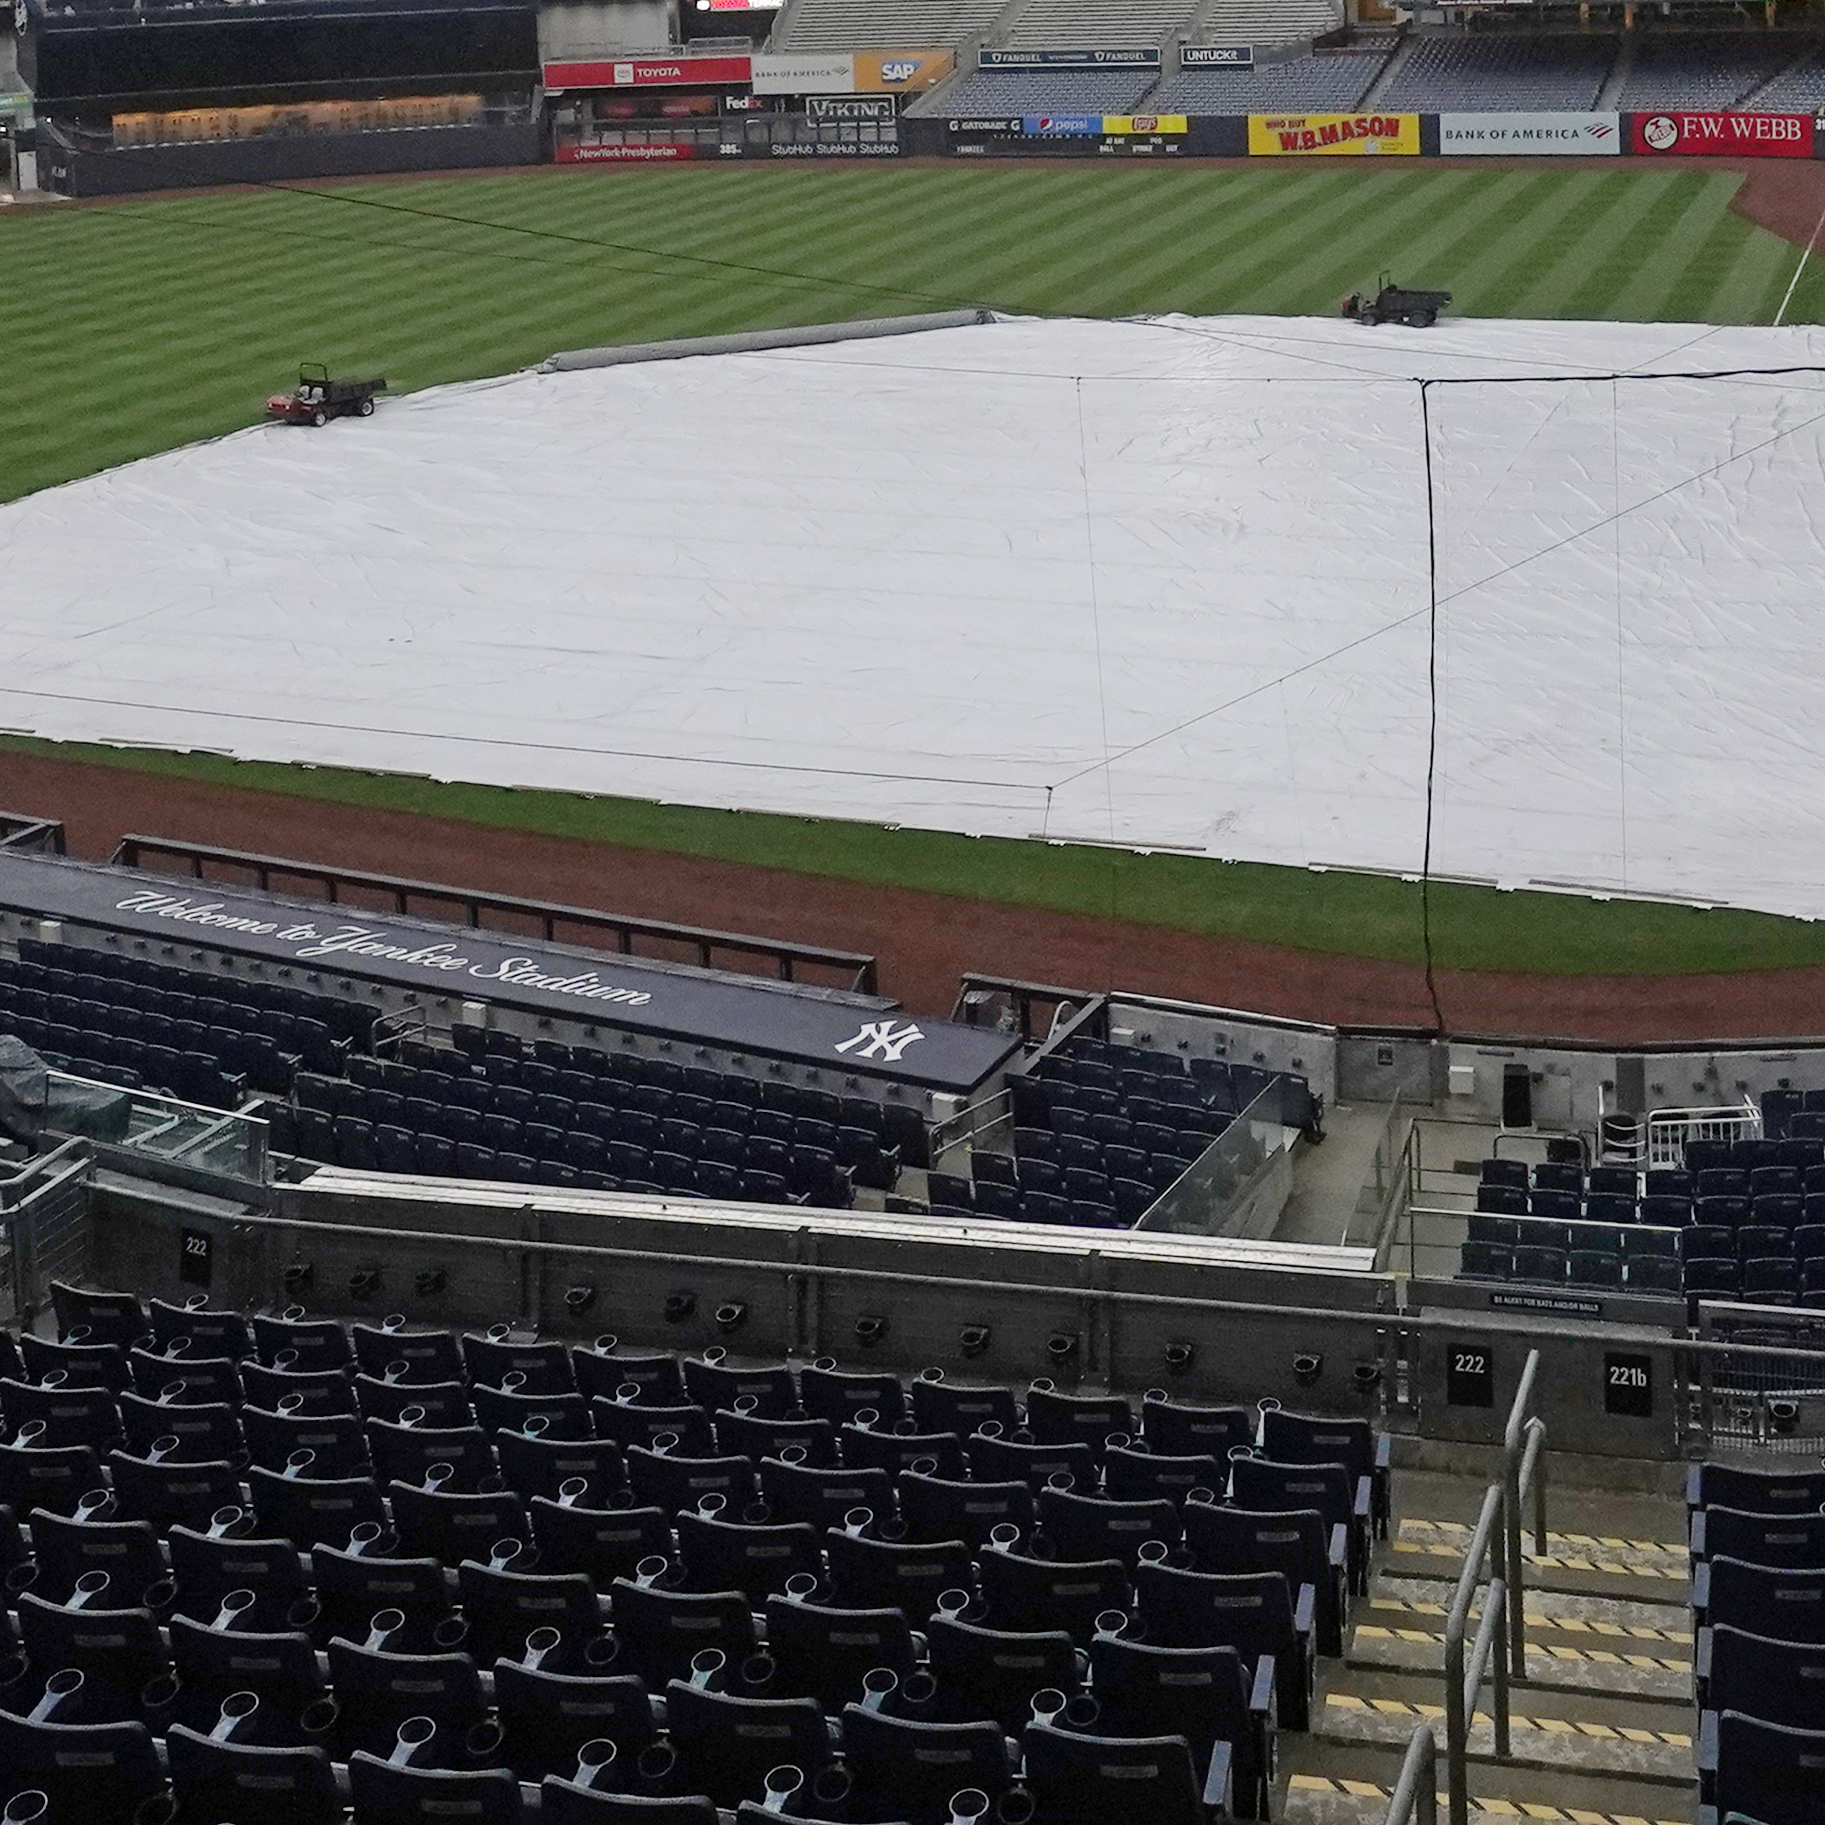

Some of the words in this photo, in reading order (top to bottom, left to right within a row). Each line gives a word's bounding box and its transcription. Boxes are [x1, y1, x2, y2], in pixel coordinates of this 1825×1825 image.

[636, 66, 681, 79] TOYOTA
[881, 62, 915, 81] SAP
[725, 96, 763, 109] FedEx
[811, 100, 889, 116] VIKING
[1055, 119, 1088, 131] pepsi
[1445, 129, 1480, 141] BANK
[1487, 128, 1505, 141] OF
[1509, 128, 1580, 141] AMERICA
[1682, 117, 1725, 139] F.W.
[1730, 117, 1802, 141] WEBB
[772, 143, 814, 155] StubHub
[816, 143, 857, 155] StubHub
[859, 143, 899, 155] StubHub
[115, 890, 277, 937] Welcome
[277, 922, 323, 943] to
[295, 925, 469, 973] Yankee
[470, 956, 653, 1007] Stadium
[185, 1235, 207, 1257] 222
[1454, 1353, 1485, 1374] 222
[1610, 1366, 1647, 1388] 221b
